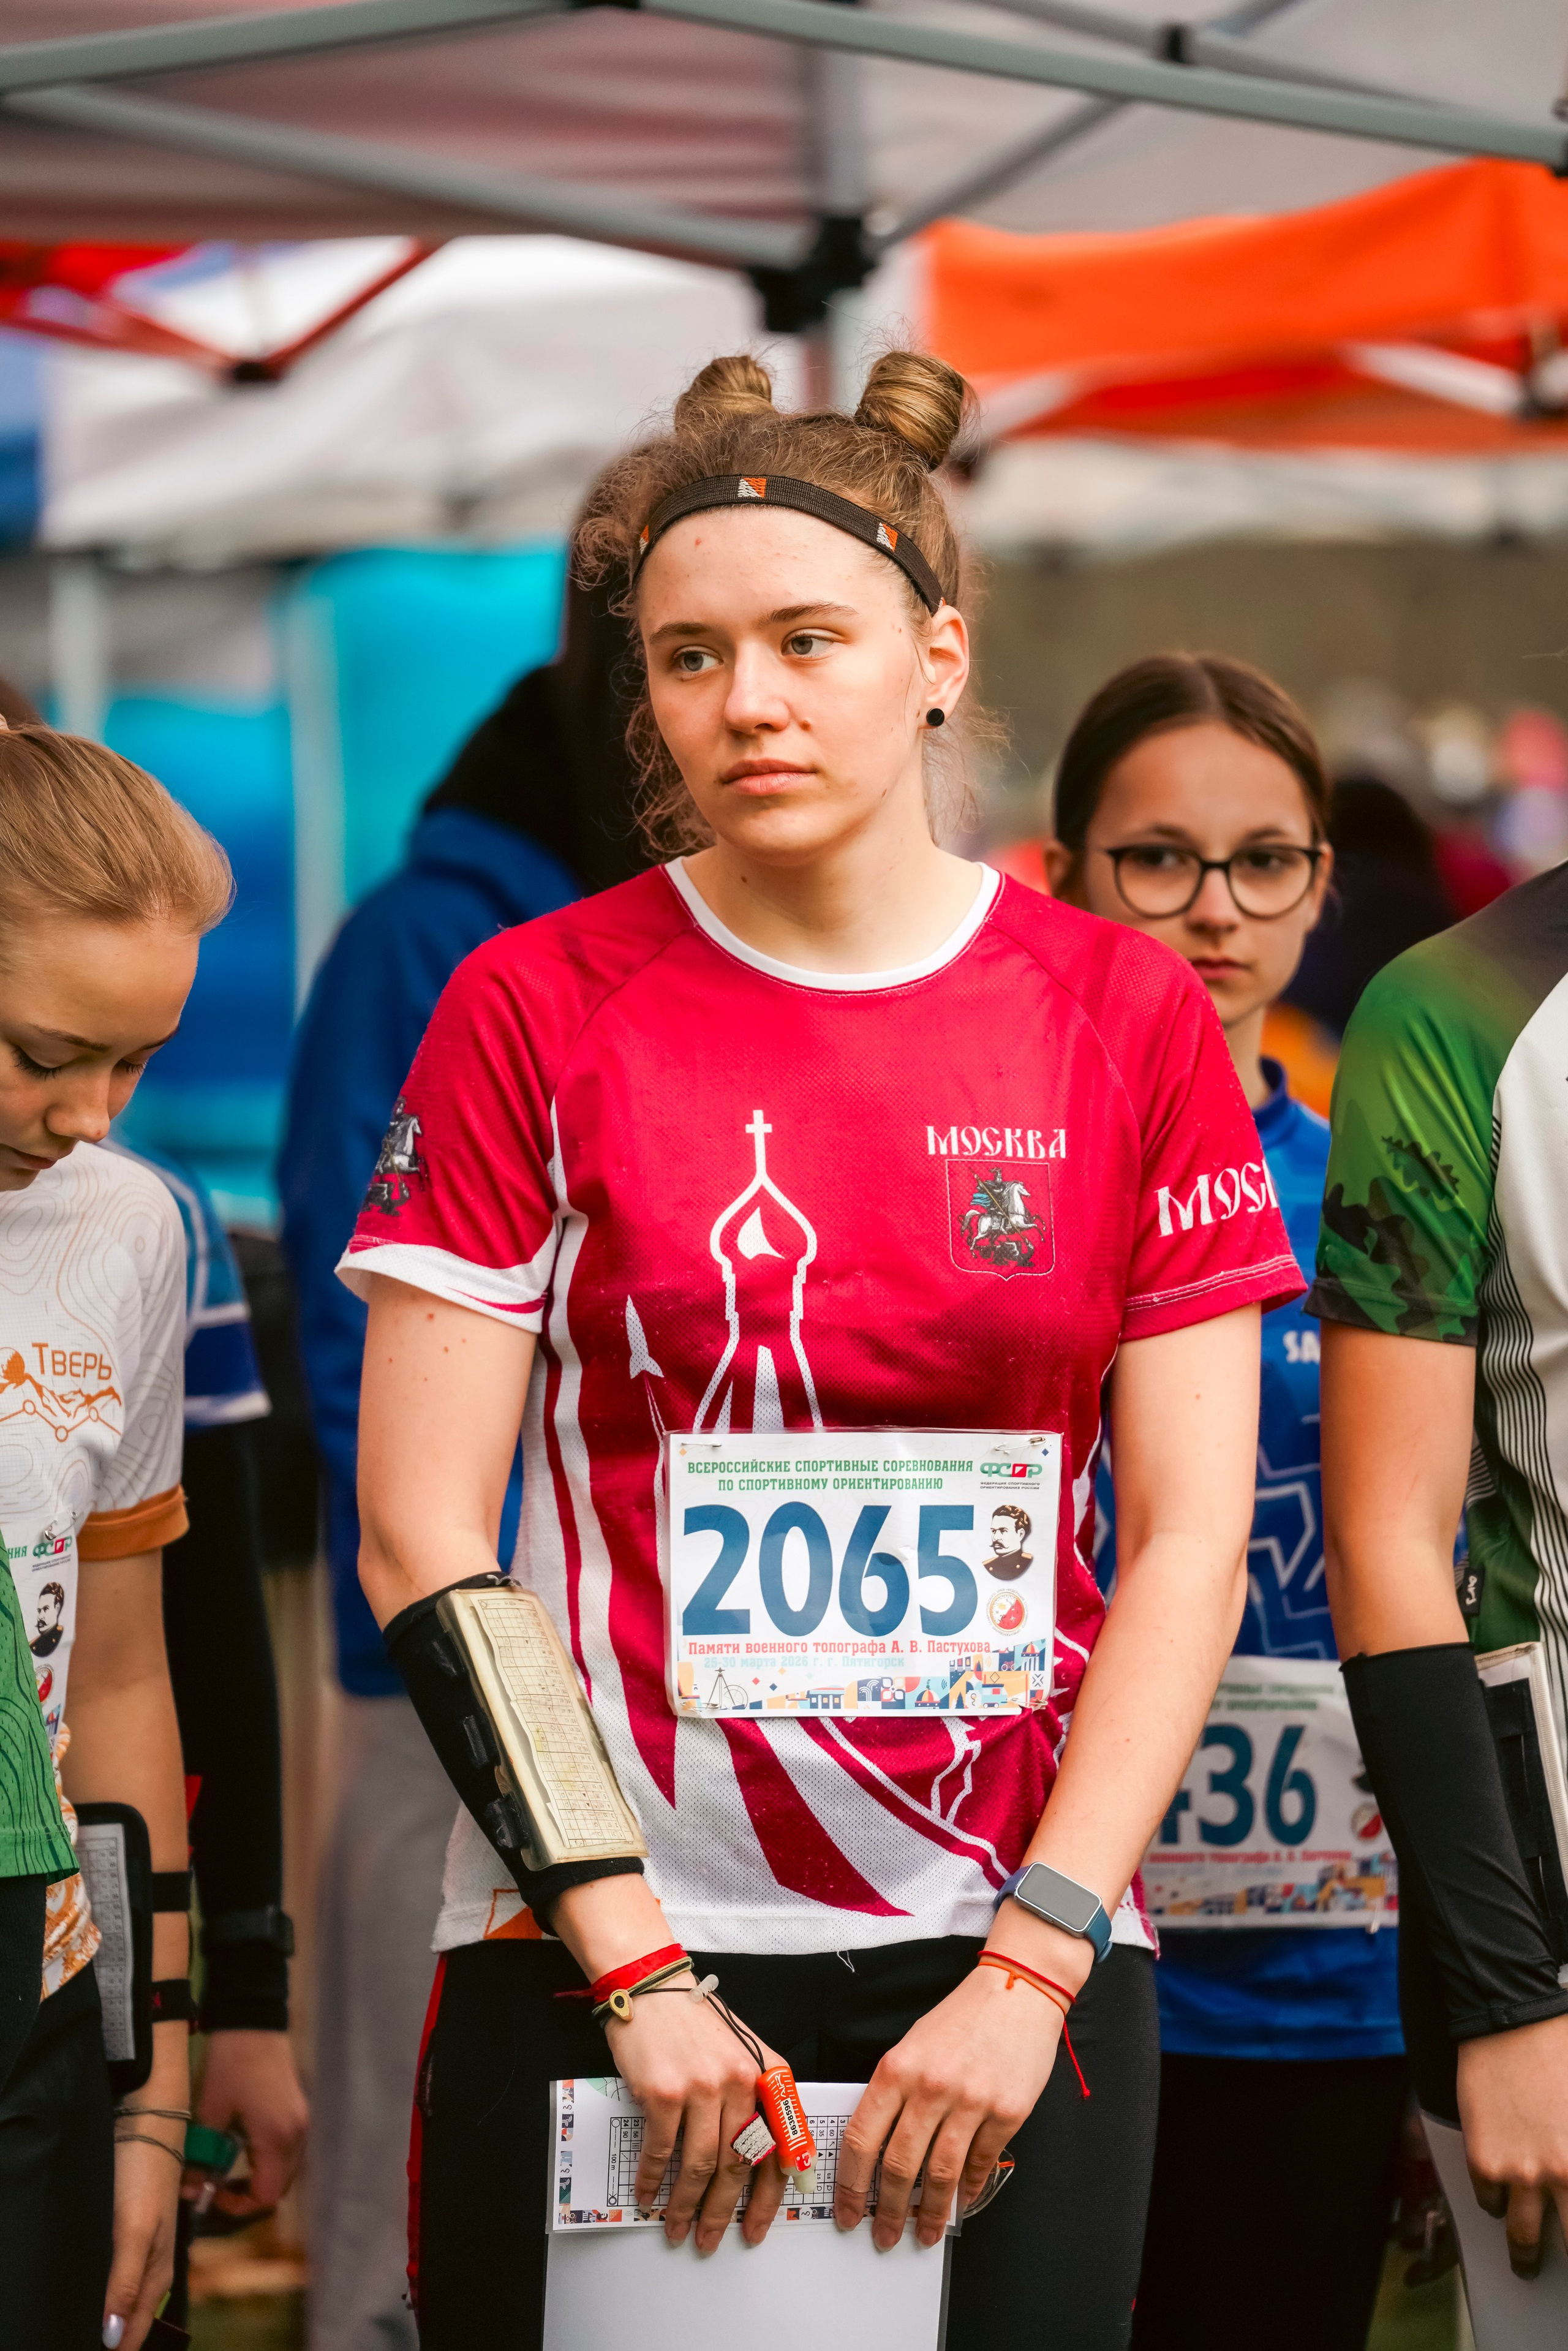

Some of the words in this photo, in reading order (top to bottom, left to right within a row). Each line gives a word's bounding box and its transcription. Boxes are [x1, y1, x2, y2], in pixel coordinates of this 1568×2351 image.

[925, 1125, 1066, 1159] МОСКВА
[688, 1459, 791, 1474] ВСЕРОССИЙСКИЕ
[795, 1460, 878, 1473] СПОРТИВНЫЕ
[883, 1459, 973, 1472] СОРЕВНОВАНИЯ
[718, 1479, 734, 1491] ПО
[739, 1478, 829, 1491] СПОРТИВНОМУ
[833, 1477, 943, 1490] ОРИЕНТИРОВАНИЮ
[682, 1500, 979, 1637] 2065
[688, 1642, 740, 1655] Памяти
[745, 1642, 807, 1653] военного
[813, 1639, 886, 1656] топографа
[891, 1640, 904, 1653] А.
[910, 1640, 922, 1653] В.
[927, 1640, 990, 1655] Пастухова
[741, 1658, 777, 1669] марта
[781, 1656, 809, 1667] 2026
[842, 1656, 905, 1669] Пятигорск
[783, 2100, 798, 2136] 8638596
